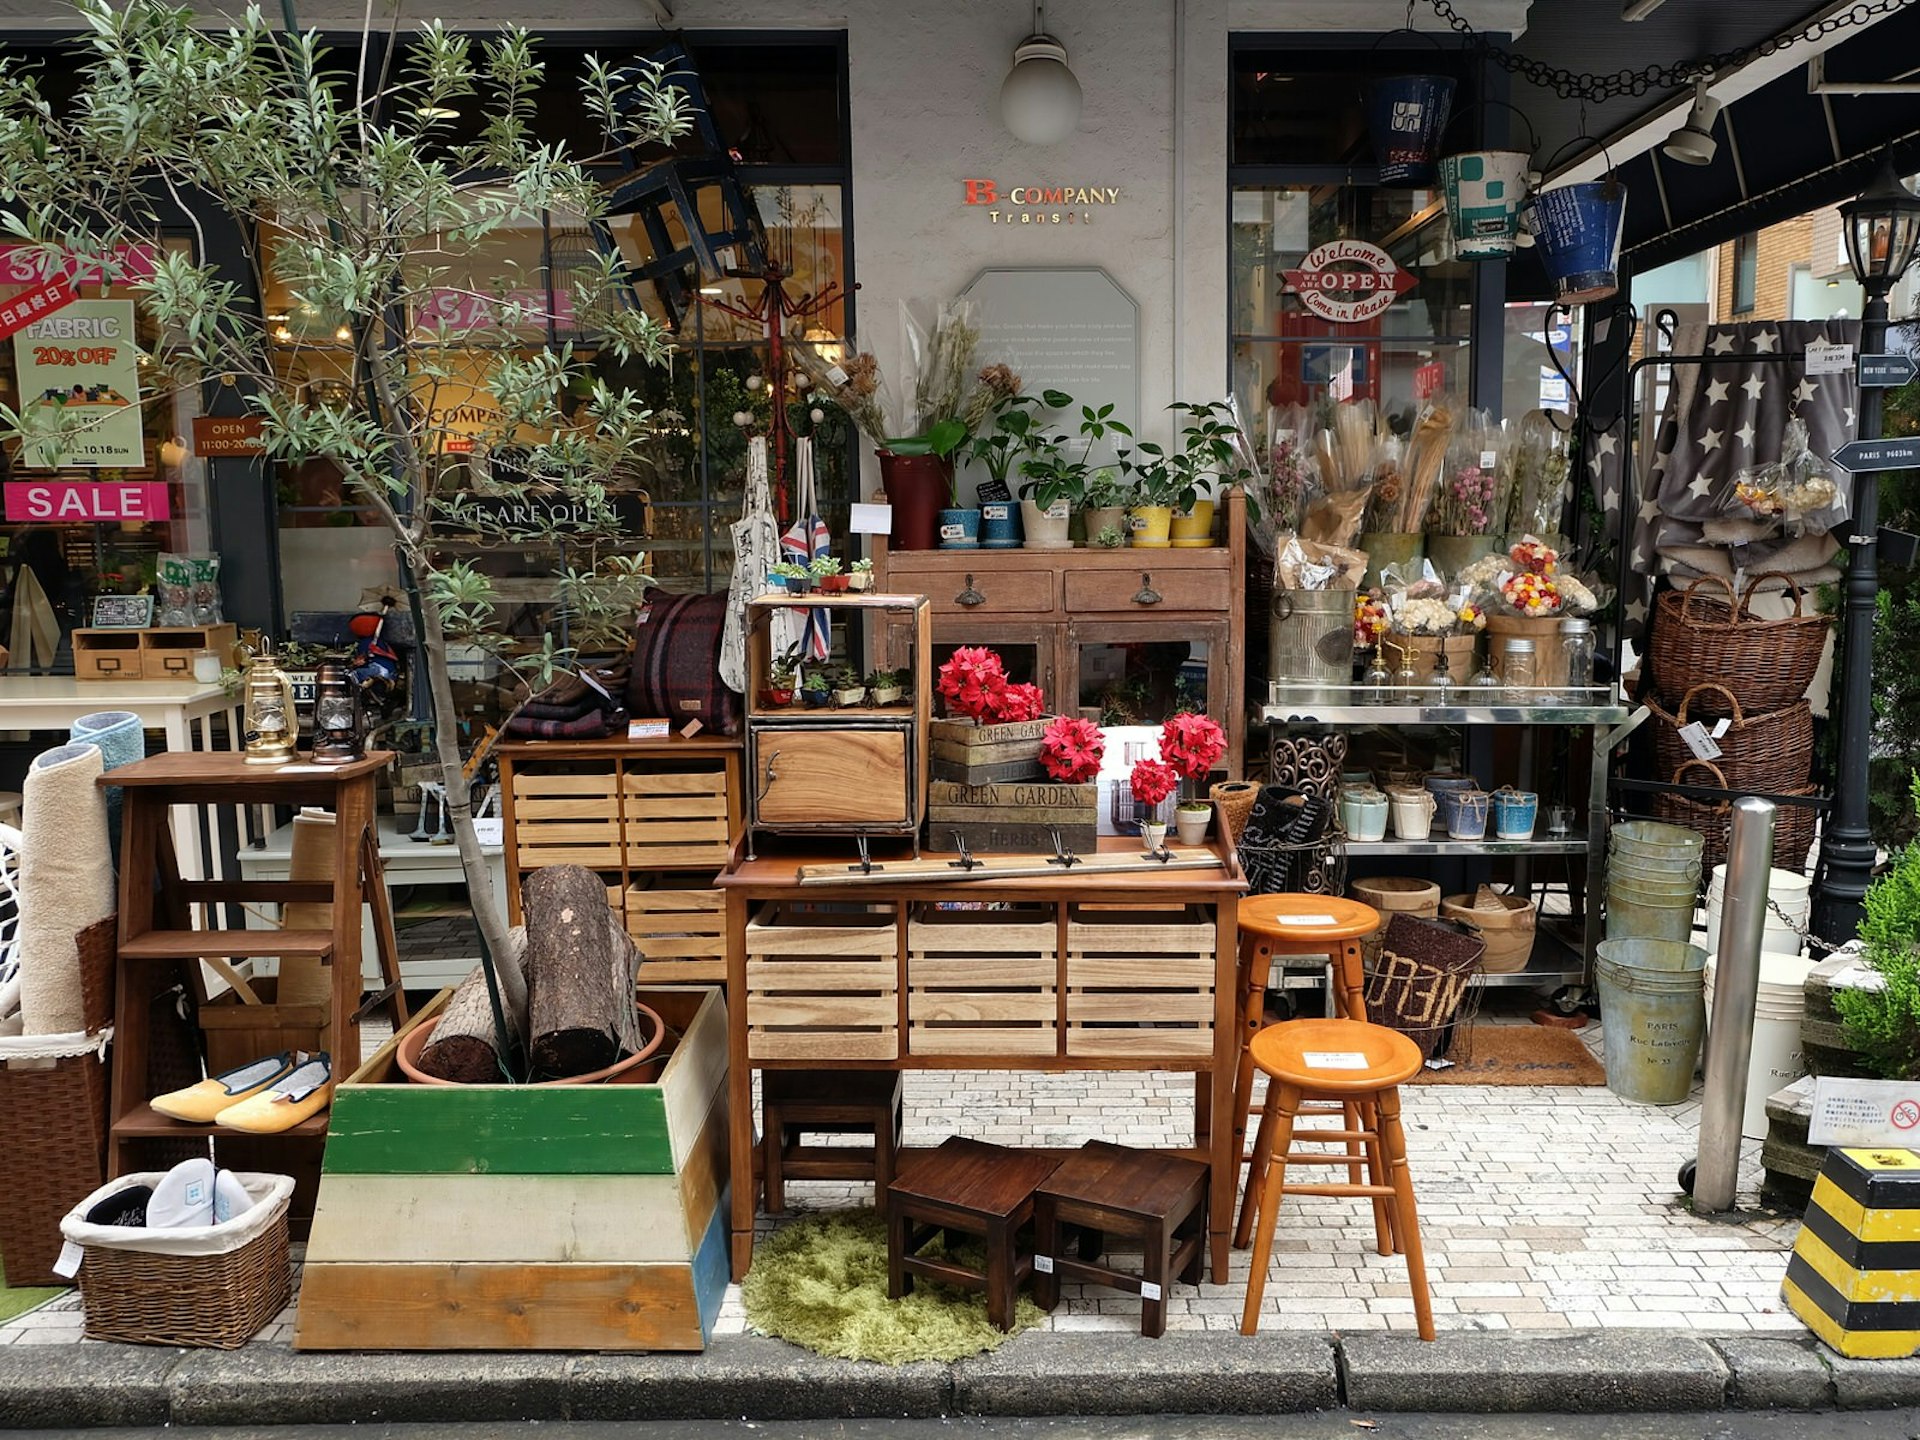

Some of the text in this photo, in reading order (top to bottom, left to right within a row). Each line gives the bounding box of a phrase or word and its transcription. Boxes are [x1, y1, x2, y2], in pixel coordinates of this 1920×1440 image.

[962, 179, 1120, 206] B-COMPANY
[990, 211, 1090, 223] Transit
[1310, 243, 1386, 268] Welcome
[1321, 273, 1395, 289] OPEN
[0, 285, 62, 328] 日最終日
[438, 294, 548, 325] SAE
[1307, 292, 1390, 319] Come in Please
[26, 316, 120, 339] FABRIC
[33, 346, 117, 366] 20% OFF
[212, 424, 246, 434] OPEN
[1860, 451, 1880, 460] PARIS
[28, 487, 144, 517] SALE
[497, 505, 540, 523] ARE
[978, 725, 1014, 743] GREEN
[949, 786, 1080, 806] GREEN GARDEN
[989, 832, 1039, 847] HERBS
